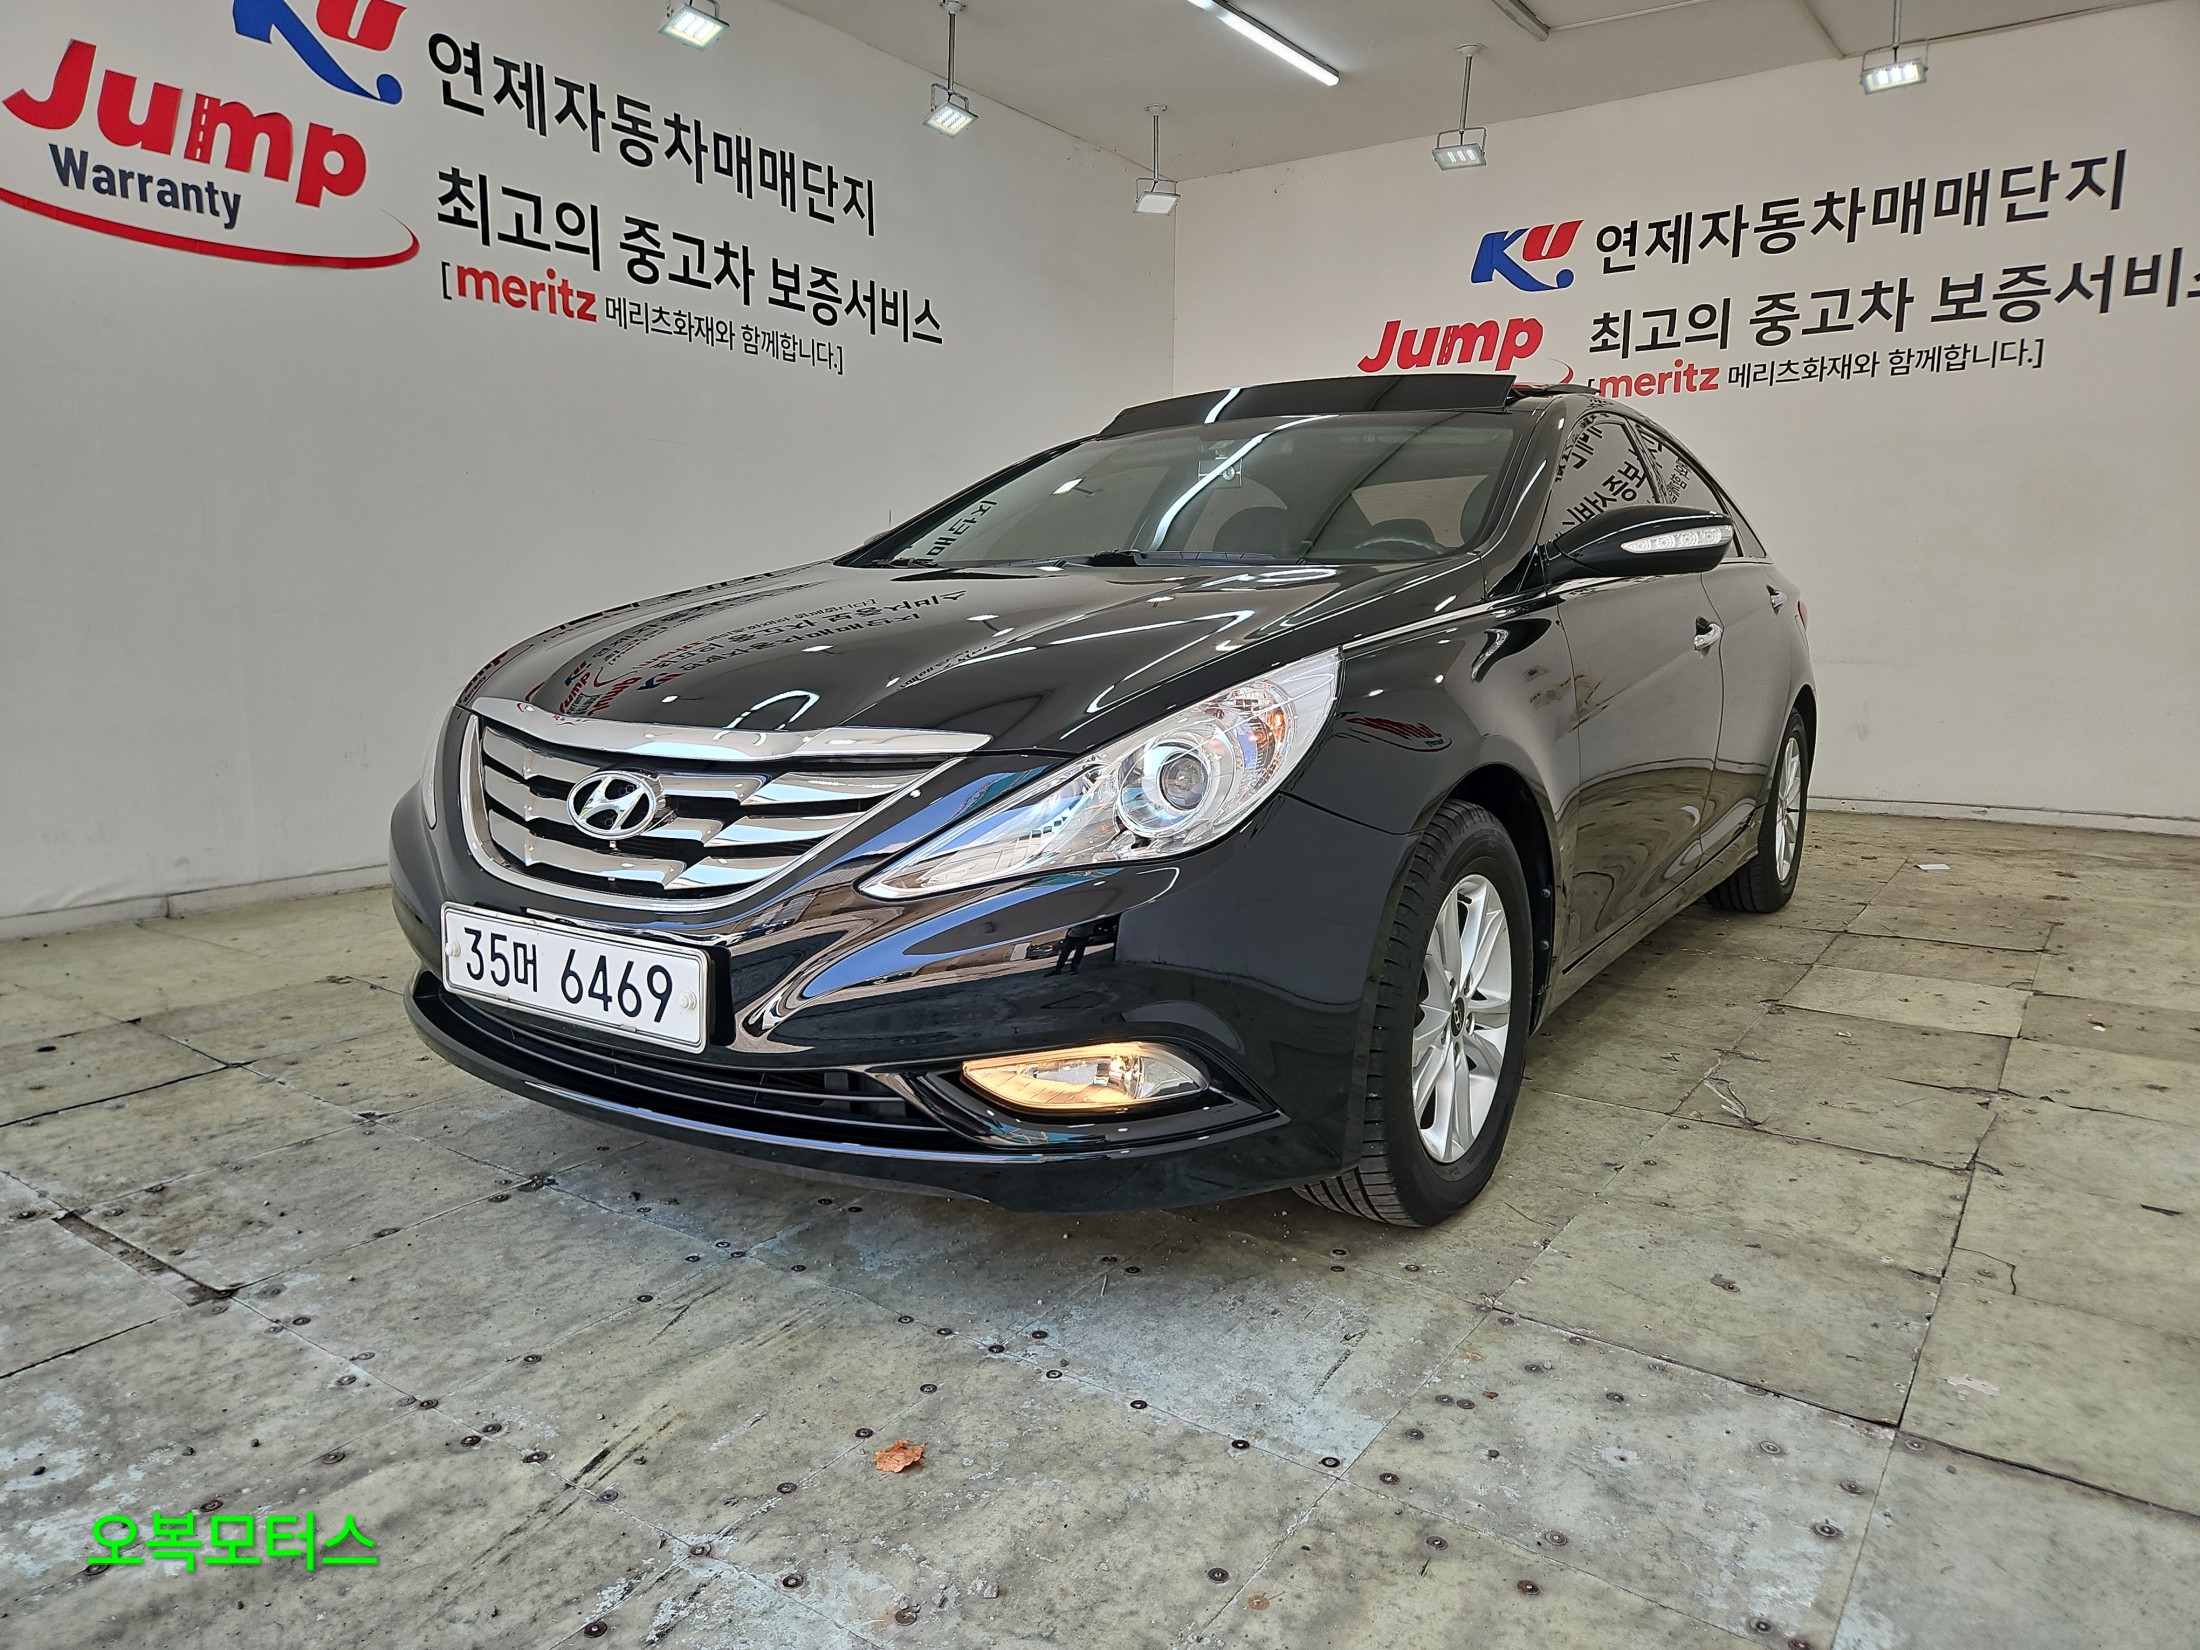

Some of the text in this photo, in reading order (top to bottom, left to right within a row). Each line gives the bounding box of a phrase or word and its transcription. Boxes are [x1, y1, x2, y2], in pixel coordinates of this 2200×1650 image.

[2, 38, 367, 208] Jump
[428, 32, 875, 237] 연제자동차매매단지
[48, 143, 241, 230] Warranty
[1596, 149, 2127, 274] 연제자동차매매단지
[437, 166, 943, 345] 최고의 중고차 보증서비스
[1588, 247, 2200, 359] 최고의 중고차 보증서비
[605, 296, 735, 350] 메리츠화재와
[1357, 317, 1543, 373] Jump
[1728, 350, 1880, 388] 메리츠화재와
[464, 926, 673, 1024] 35머 6469
